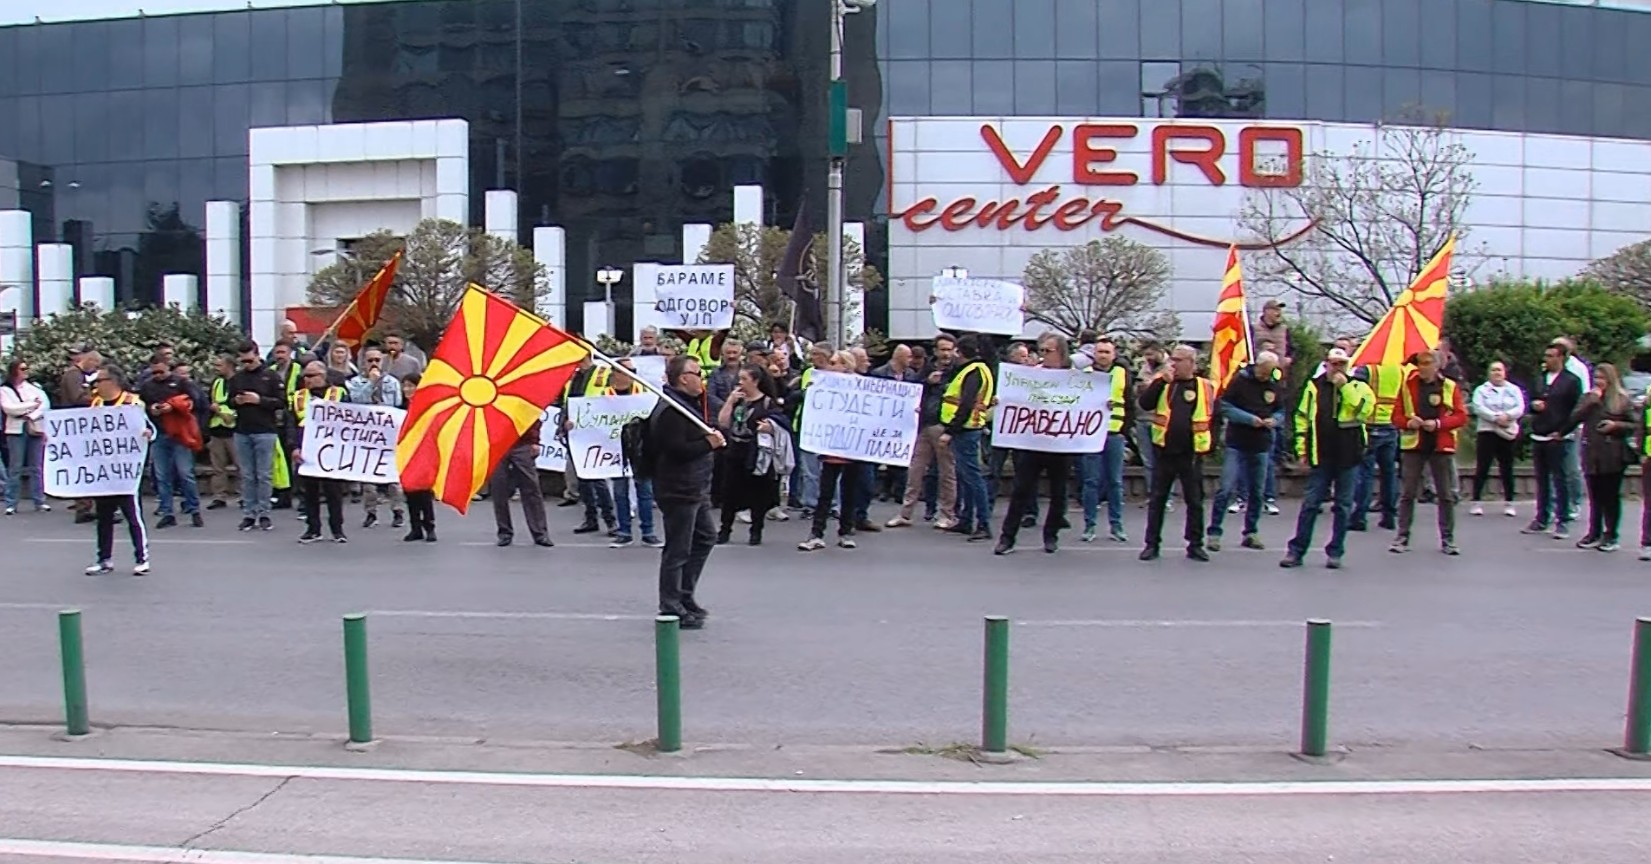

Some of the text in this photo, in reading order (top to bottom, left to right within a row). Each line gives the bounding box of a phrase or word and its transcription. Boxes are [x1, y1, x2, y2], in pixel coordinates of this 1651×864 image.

[980, 123, 1302, 188] VERO
[900, 185, 1128, 232] center
[657, 272, 726, 286] БАРАМЕ
[656, 299, 729, 312] ОДГОВОР
[680, 312, 713, 326] УЈП
[812, 389, 906, 418] СТУДЕТИ
[50, 413, 128, 437] УПРАВА
[312, 405, 395, 428] ПРАВДАТА
[999, 405, 1103, 439] ПРАВЕДНО
[314, 425, 387, 446] ГИ СТИГА
[47, 436, 141, 461] ЗА ЈАВНА
[317, 443, 394, 477] СИТЕ
